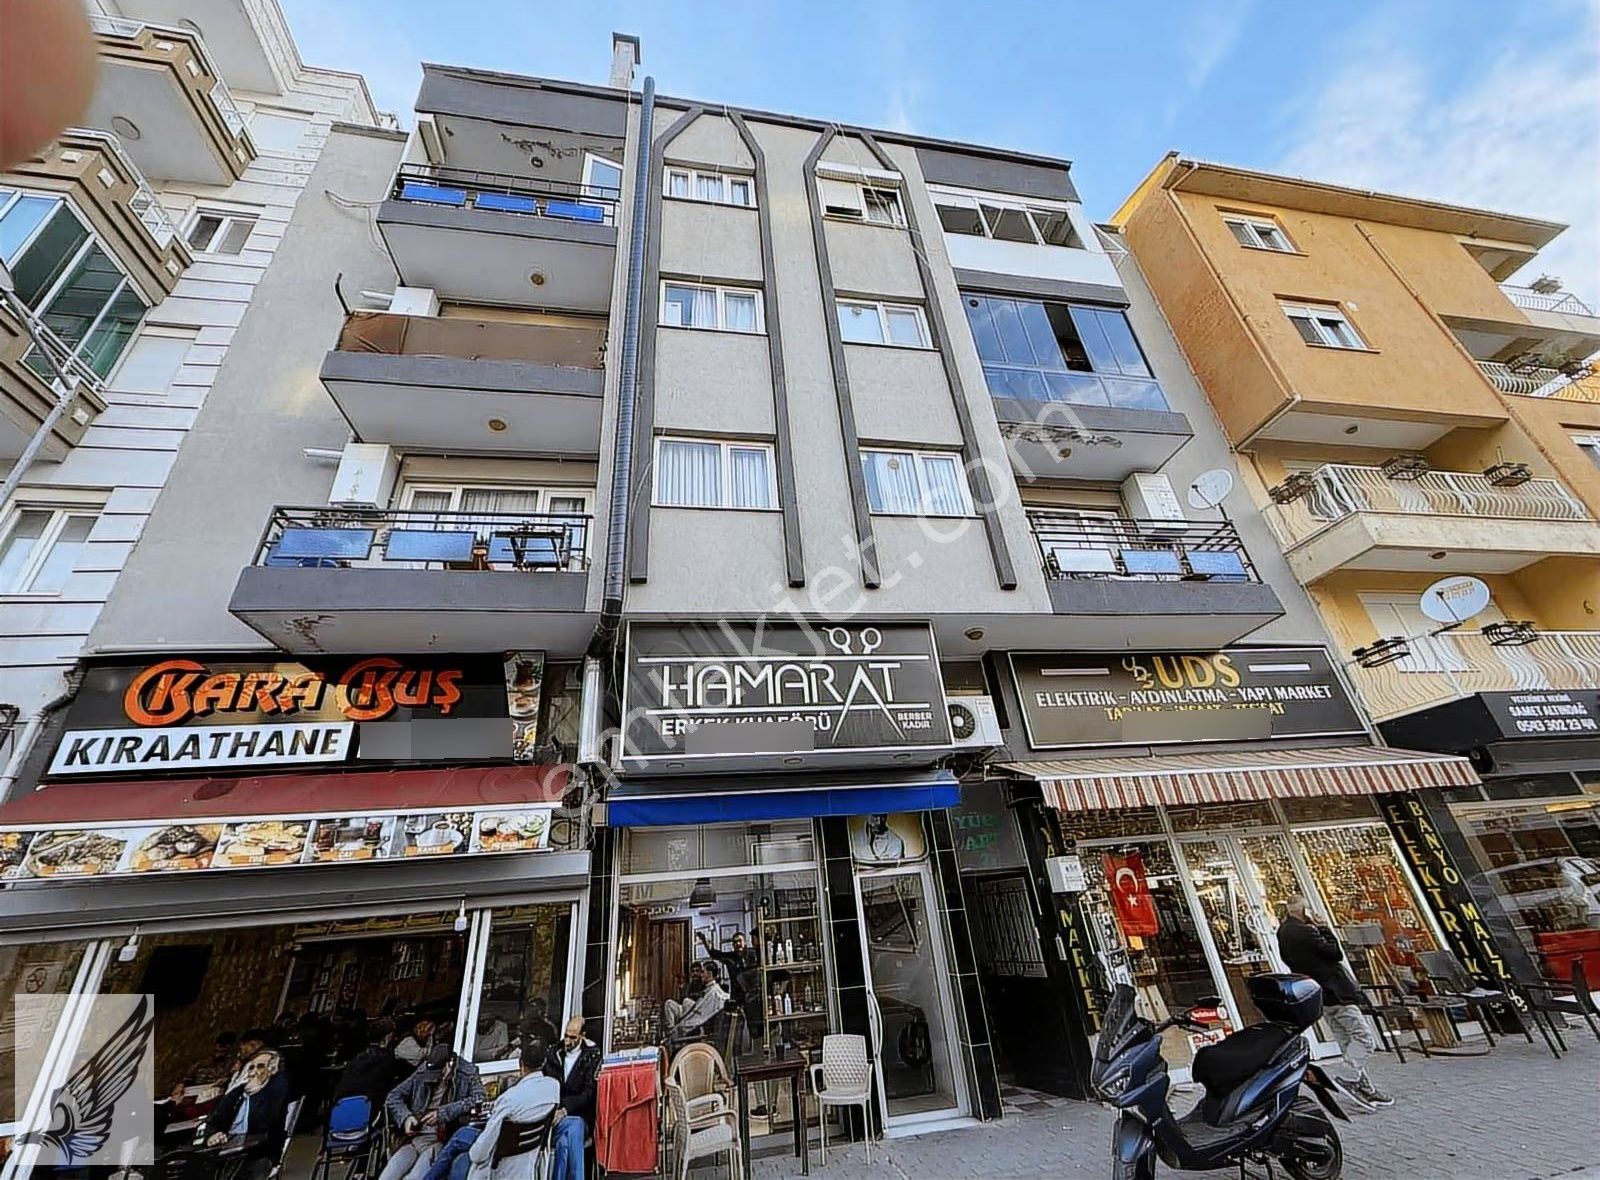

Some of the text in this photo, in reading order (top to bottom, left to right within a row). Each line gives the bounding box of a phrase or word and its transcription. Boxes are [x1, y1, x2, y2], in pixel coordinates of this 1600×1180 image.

[662, 661, 903, 716] HAMARAT
[1151, 654, 1242, 689] UDS
[1131, 687, 1228, 704] AYDINLATMA
[1237, 685, 1273, 702] YAPI
[1276, 684, 1333, 701] MARKET
[63, 725, 342, 767] KIRAATHANE
[1408, 801, 1459, 885] BANYO
